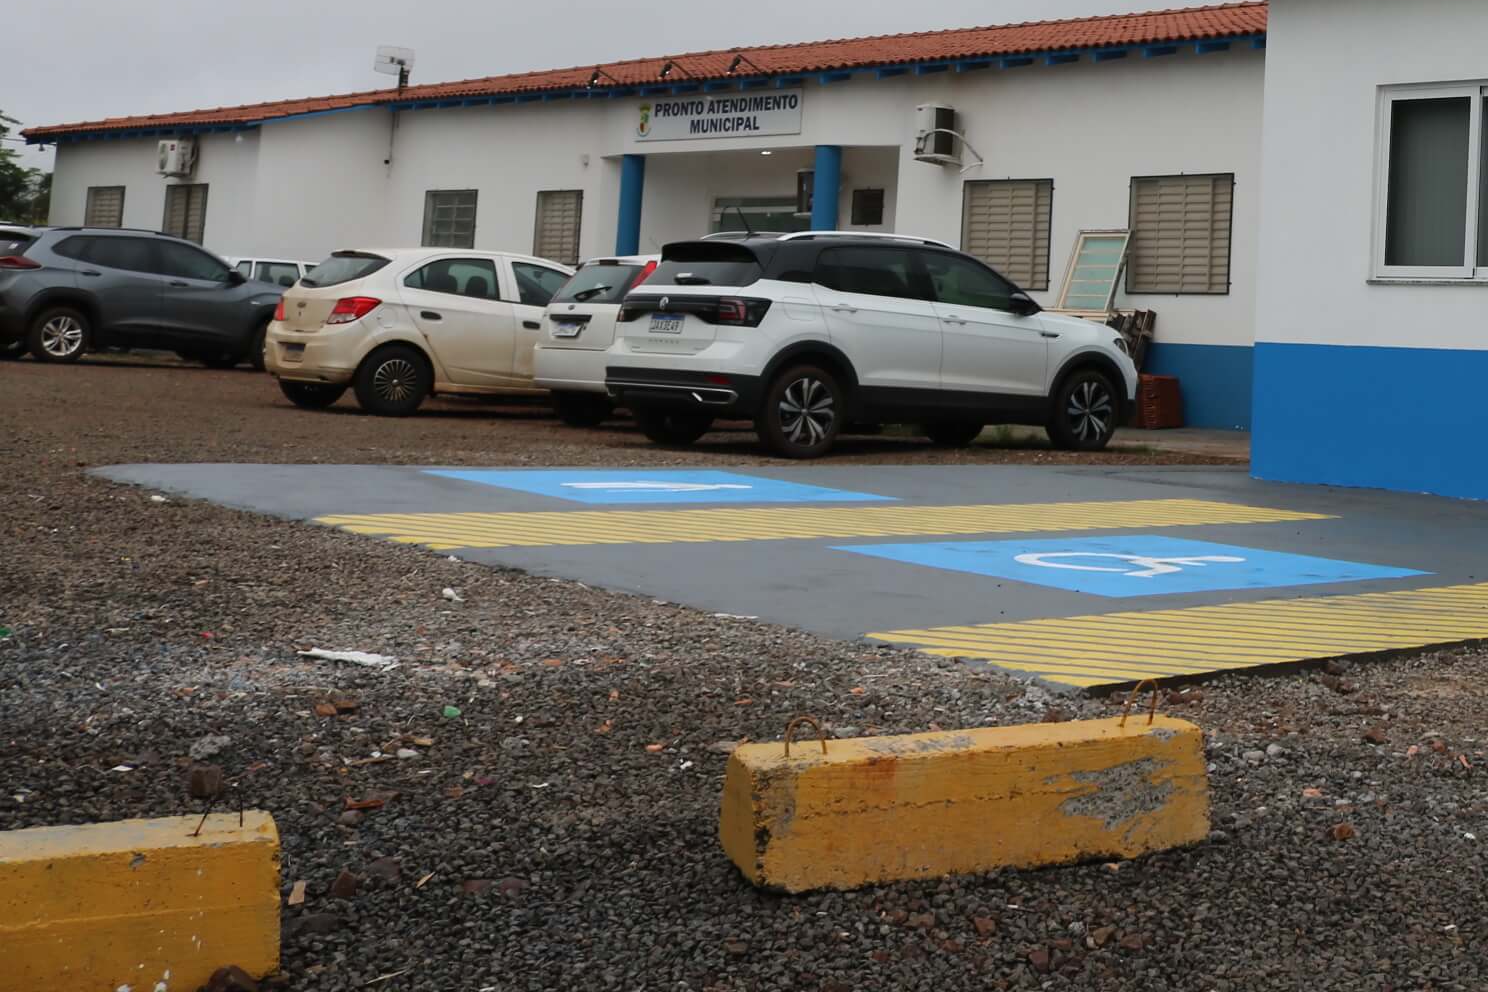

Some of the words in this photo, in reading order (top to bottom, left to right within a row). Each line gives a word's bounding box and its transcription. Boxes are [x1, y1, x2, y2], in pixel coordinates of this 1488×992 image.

[654, 101, 703, 117] PRONTO
[707, 94, 798, 114] ATENDIMENTO
[690, 116, 760, 134] MUNICIPAL
